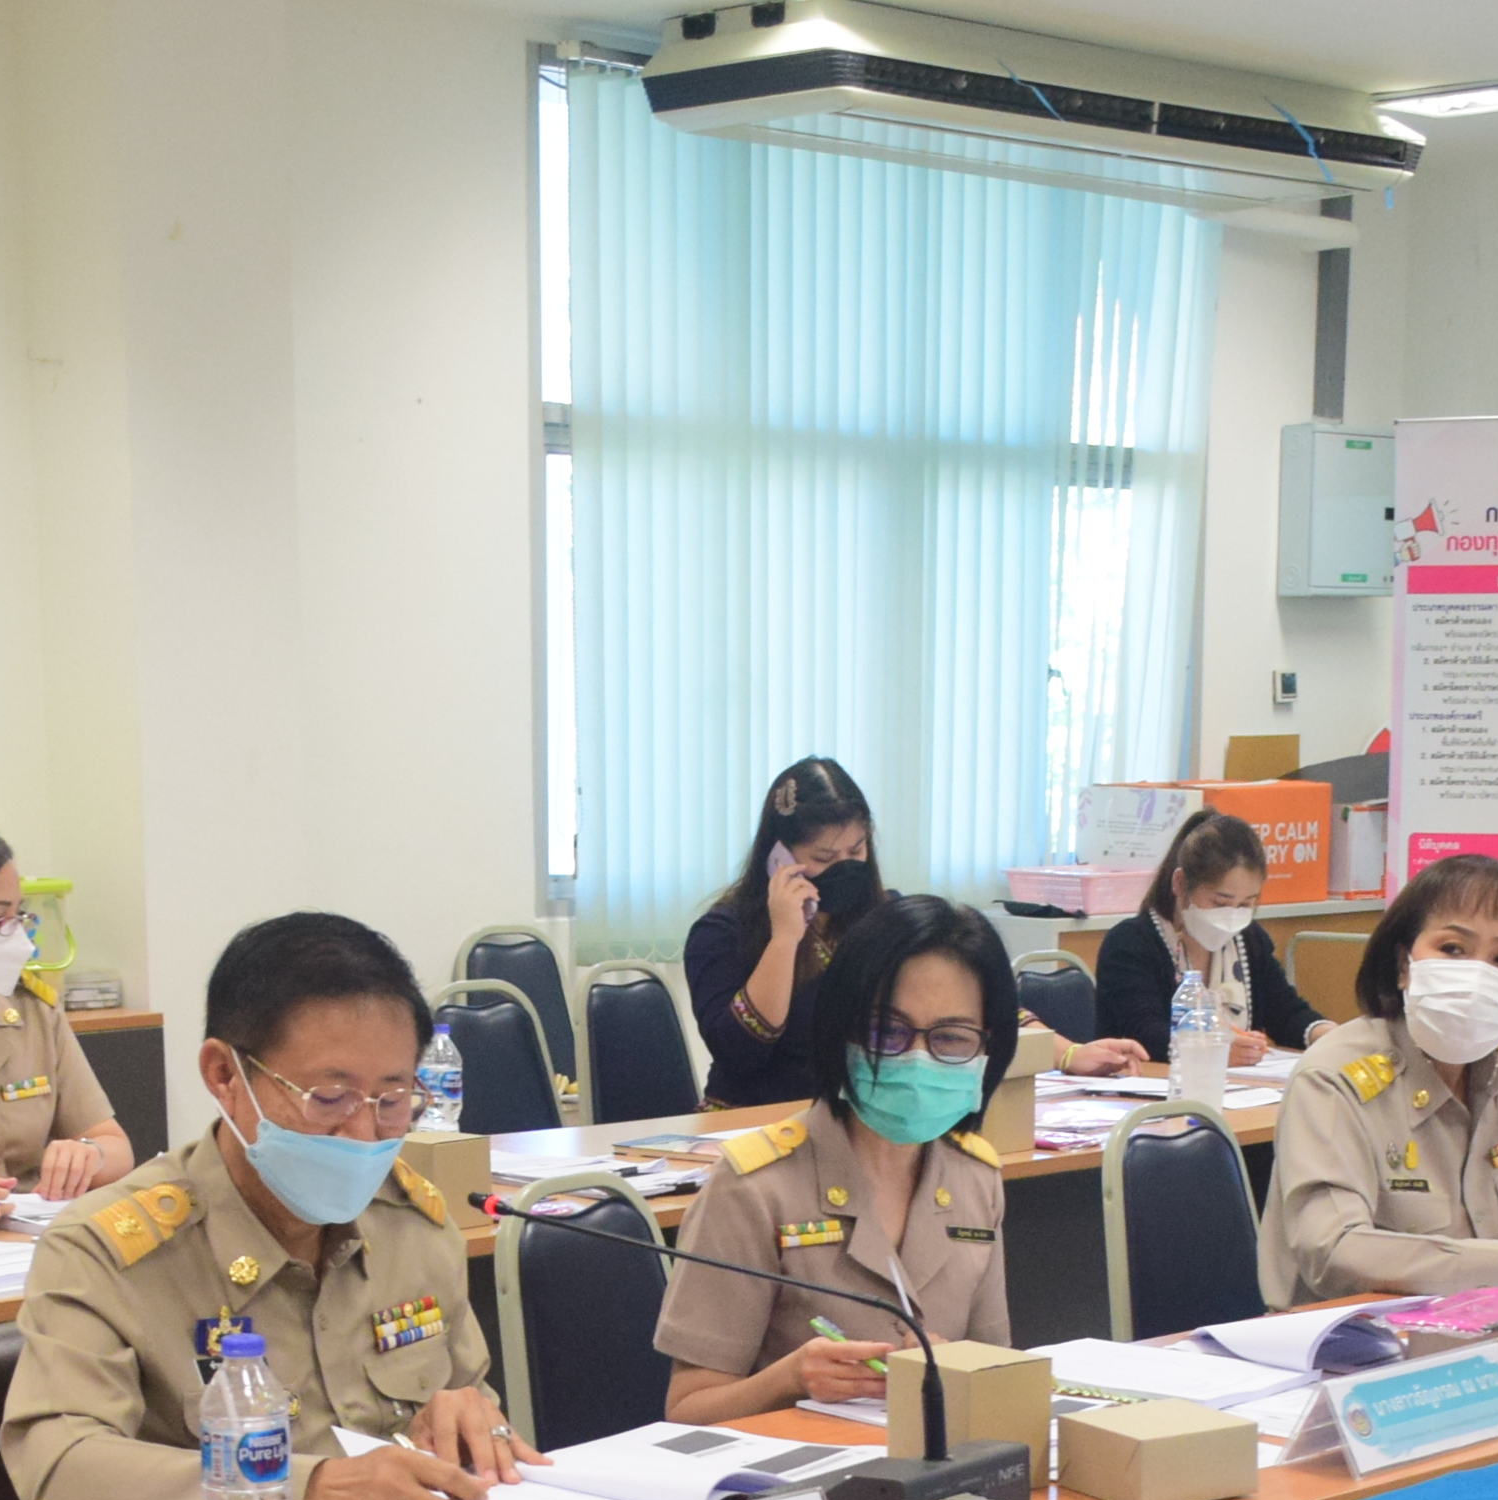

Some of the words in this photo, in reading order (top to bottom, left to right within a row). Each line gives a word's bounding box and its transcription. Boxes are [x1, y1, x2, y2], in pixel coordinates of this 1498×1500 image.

[1274, 821, 1319, 842] CALM
[1292, 843, 1319, 864] ON
[238, 1447, 272, 1463] Pure
